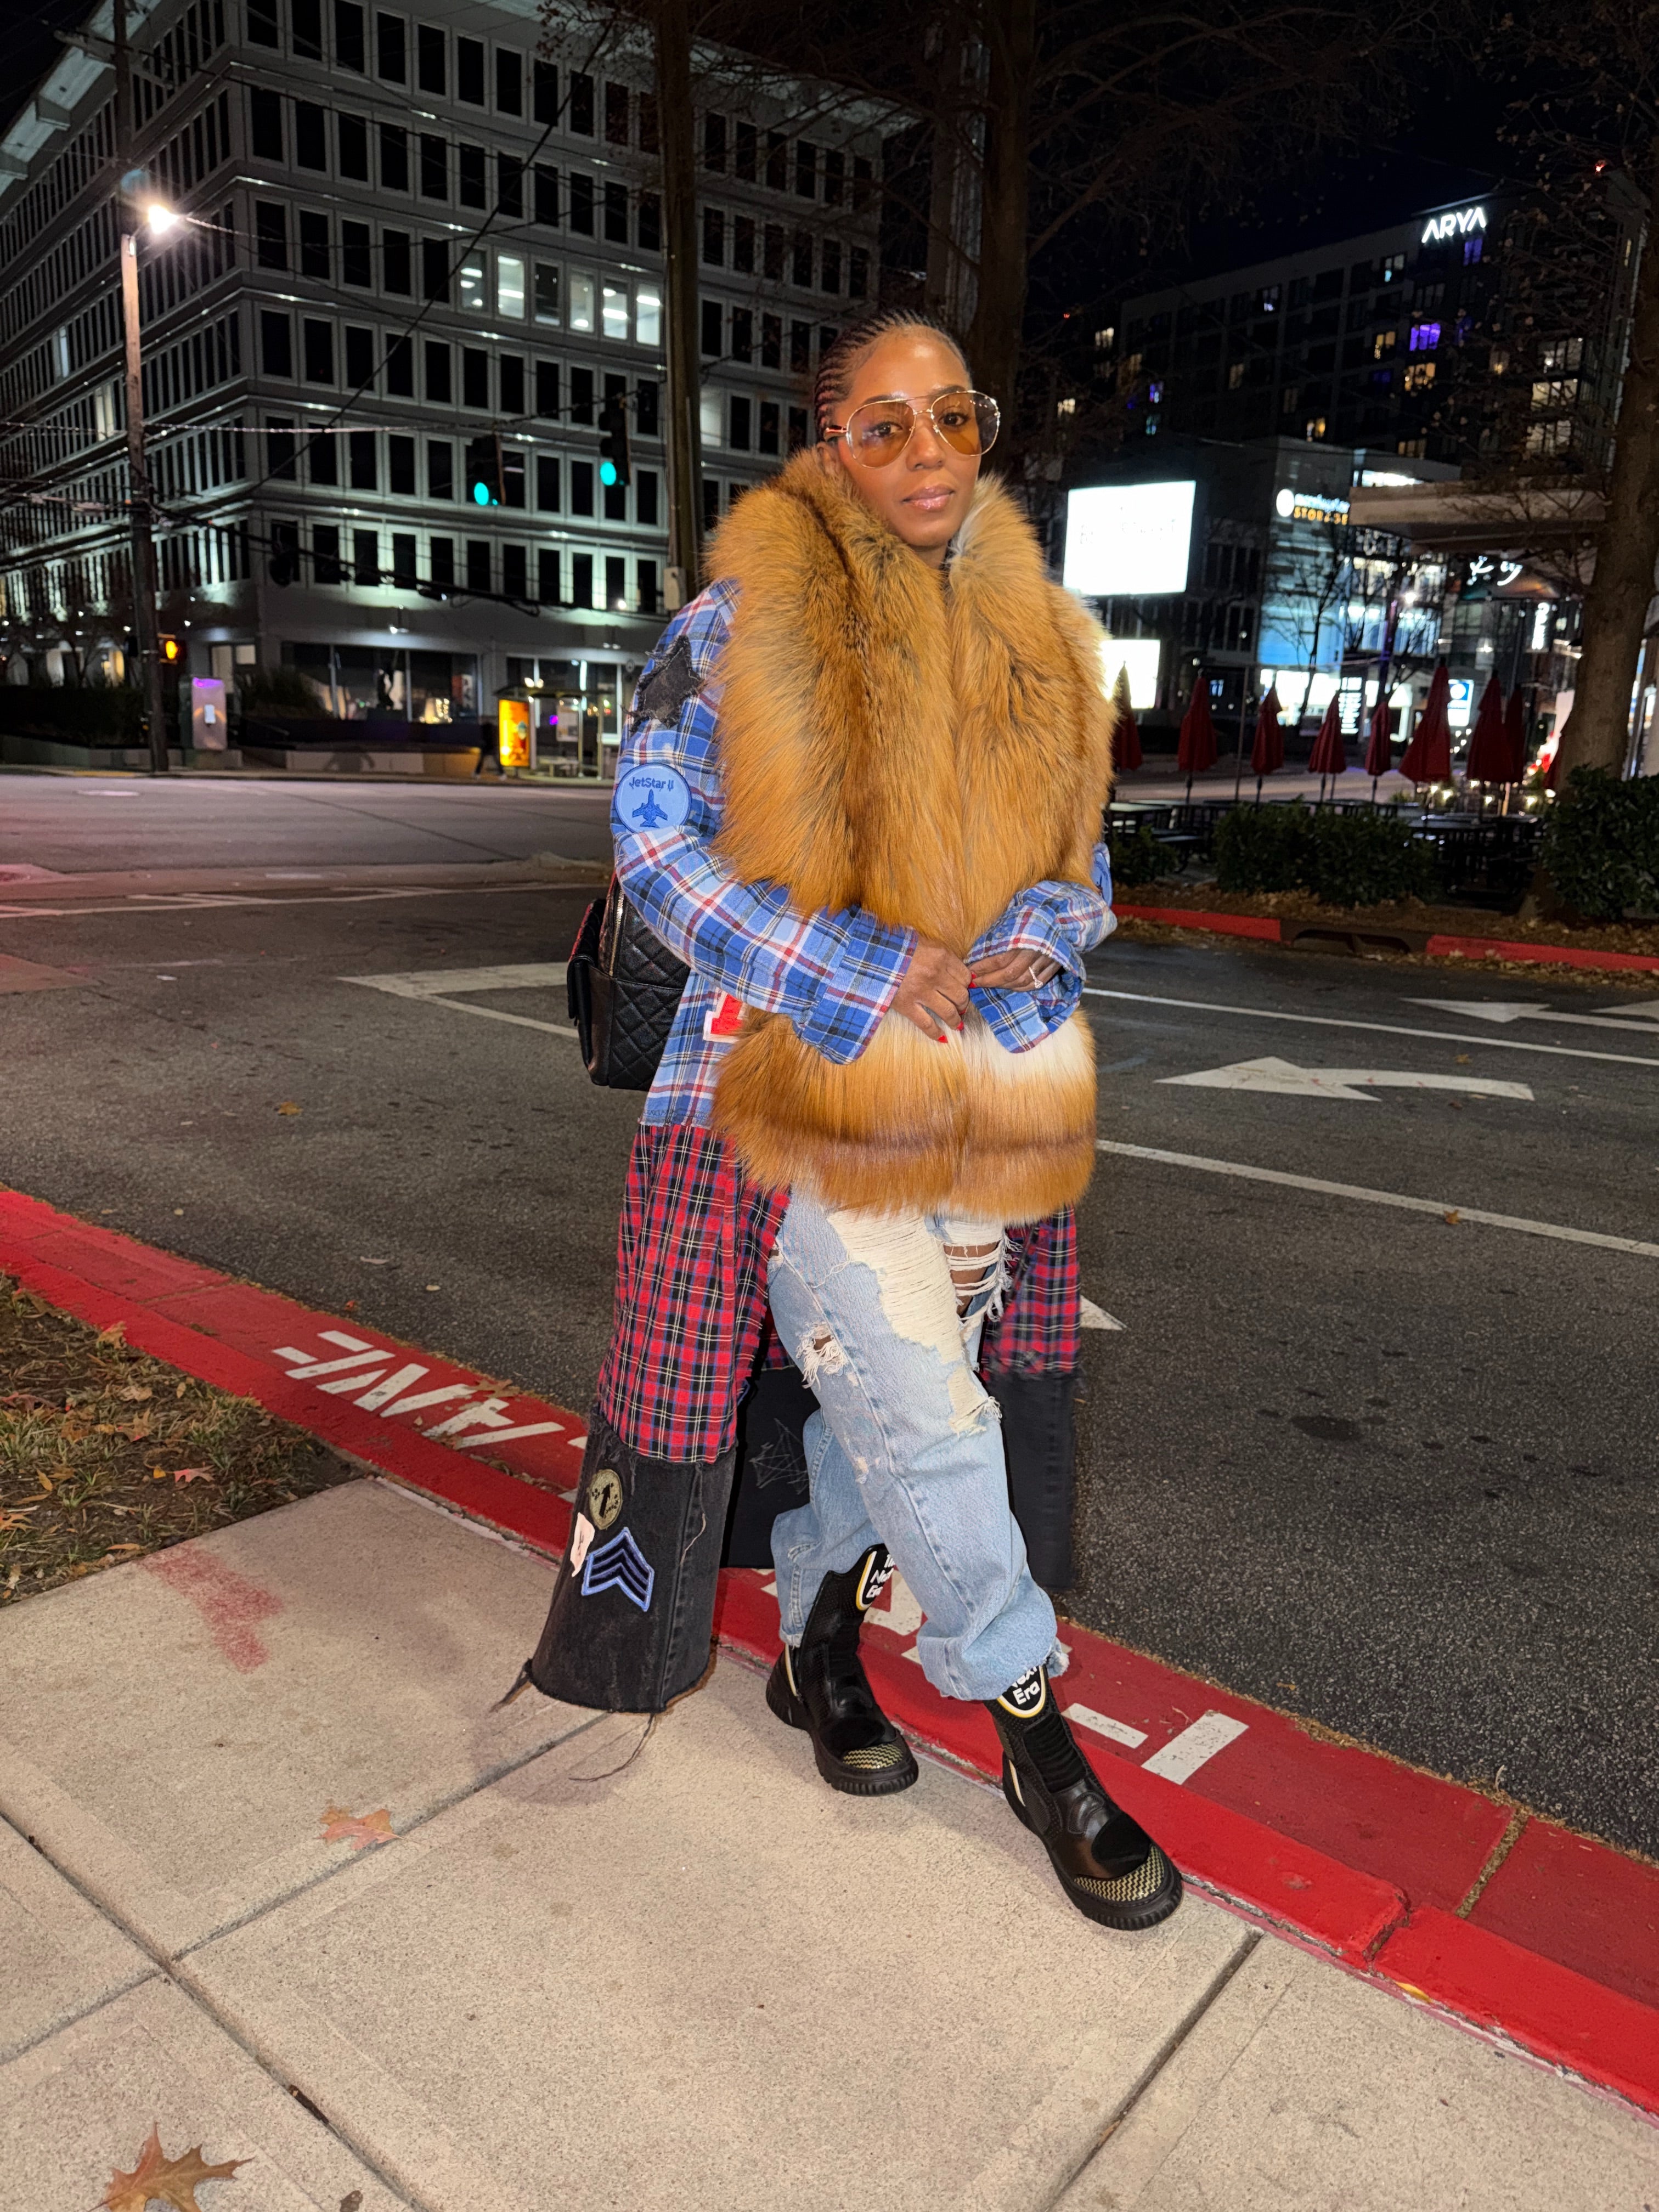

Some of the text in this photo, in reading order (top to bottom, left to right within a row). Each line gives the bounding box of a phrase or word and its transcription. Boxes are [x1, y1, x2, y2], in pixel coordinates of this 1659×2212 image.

[1421, 207, 1487, 243] ARYA
[629, 777, 666, 791] JetStar
[1012, 1681, 1040, 1705] Era
